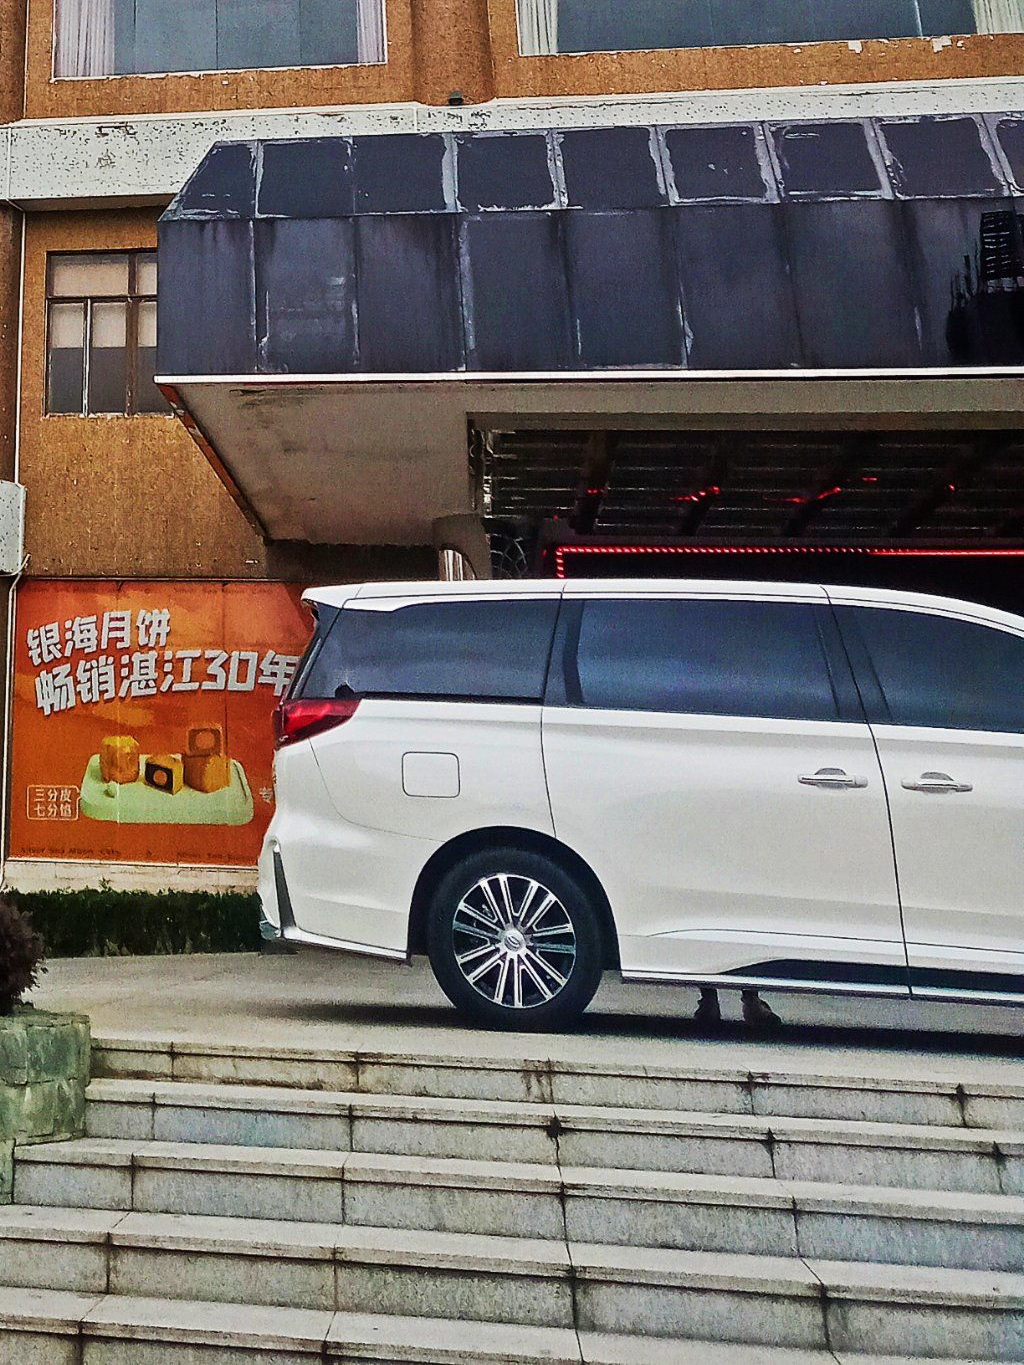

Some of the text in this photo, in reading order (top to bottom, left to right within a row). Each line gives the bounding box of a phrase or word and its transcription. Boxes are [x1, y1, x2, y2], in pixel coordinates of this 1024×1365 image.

[26, 608, 171, 666] 银海月饼
[34, 649, 301, 716] 畅销湛江30年
